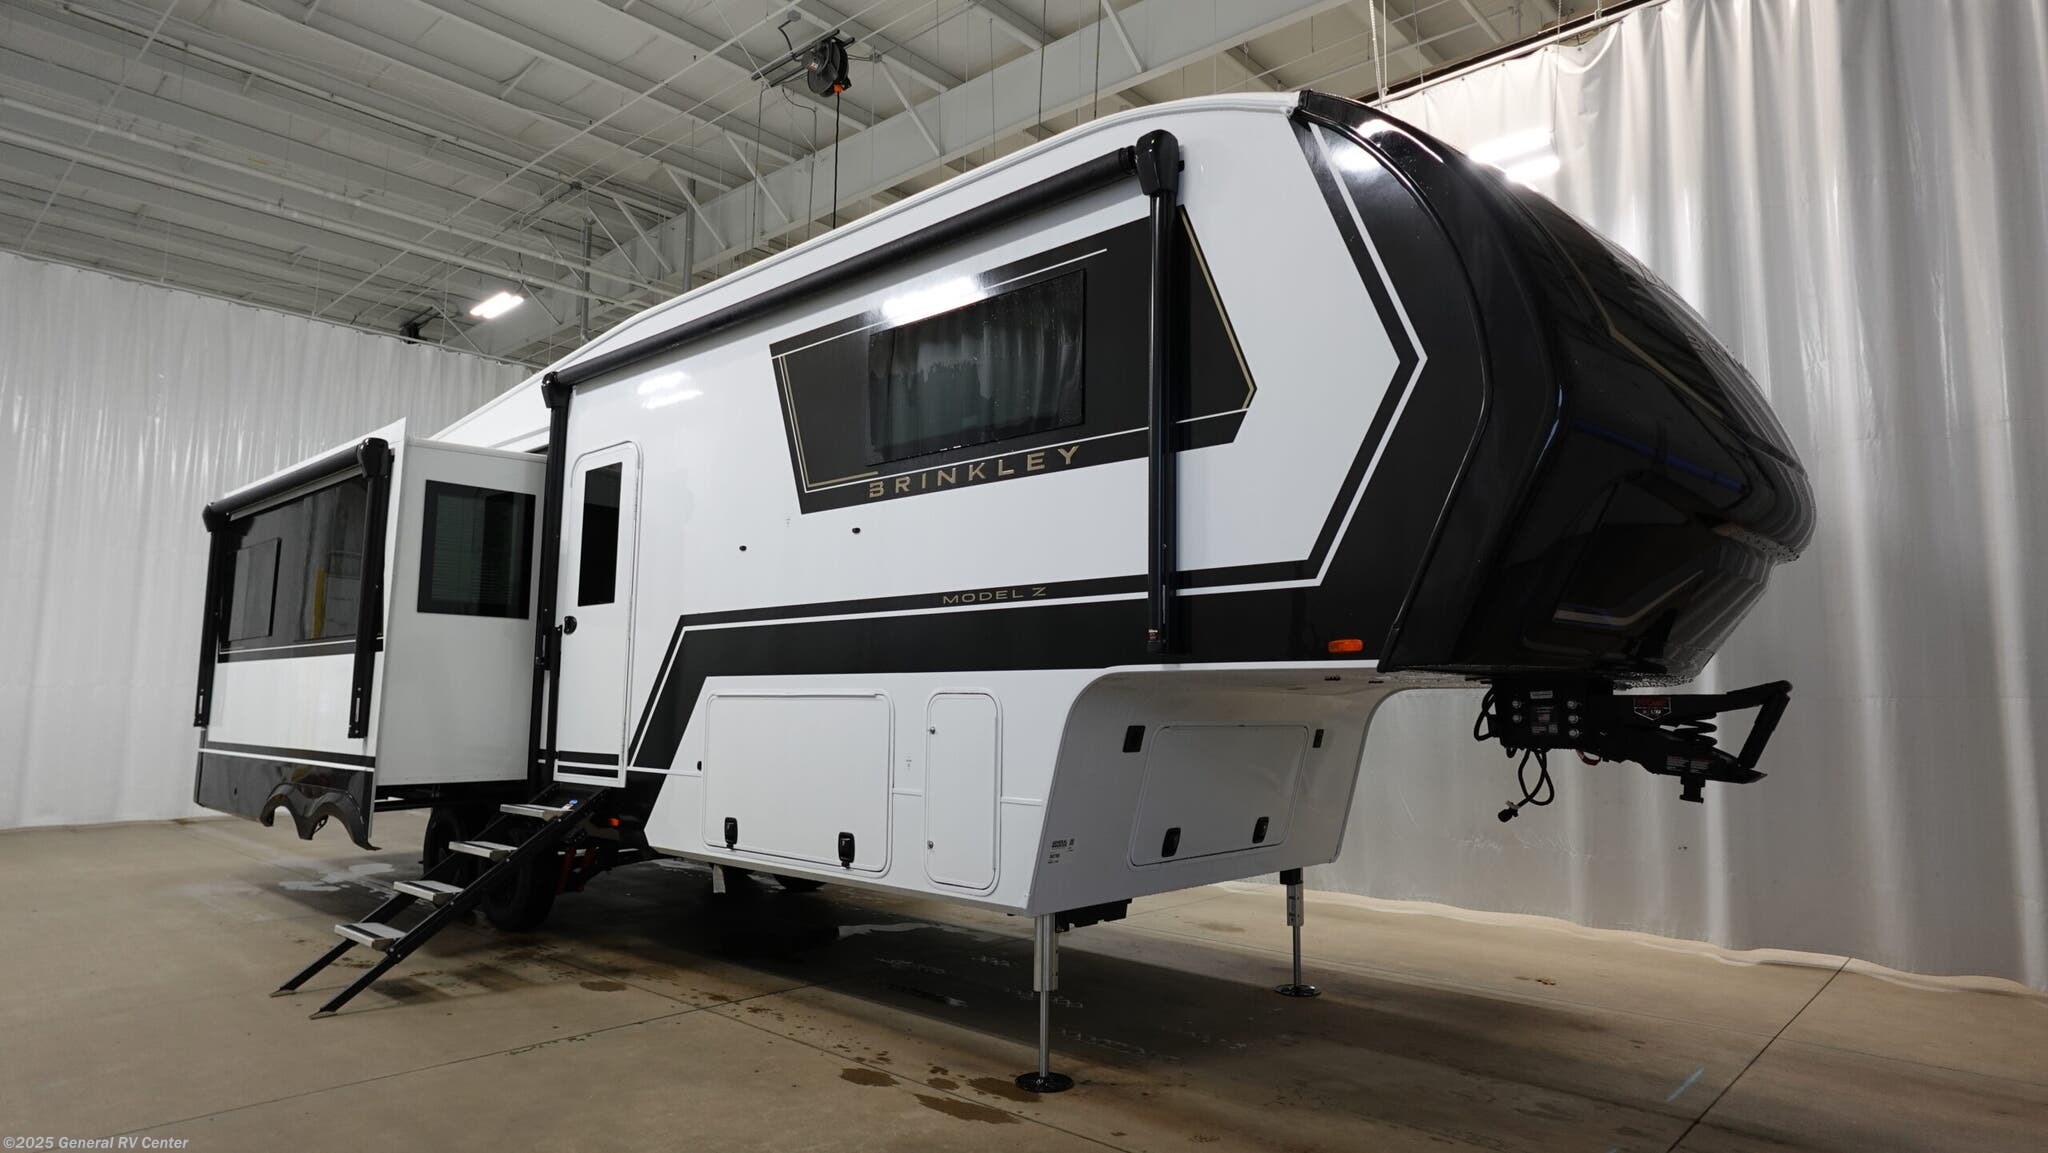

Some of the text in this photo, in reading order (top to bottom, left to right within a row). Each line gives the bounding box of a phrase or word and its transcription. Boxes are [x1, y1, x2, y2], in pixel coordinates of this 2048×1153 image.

[869, 445, 1079, 498] BRINKLEY
[943, 587, 1047, 604] MODEL Z
